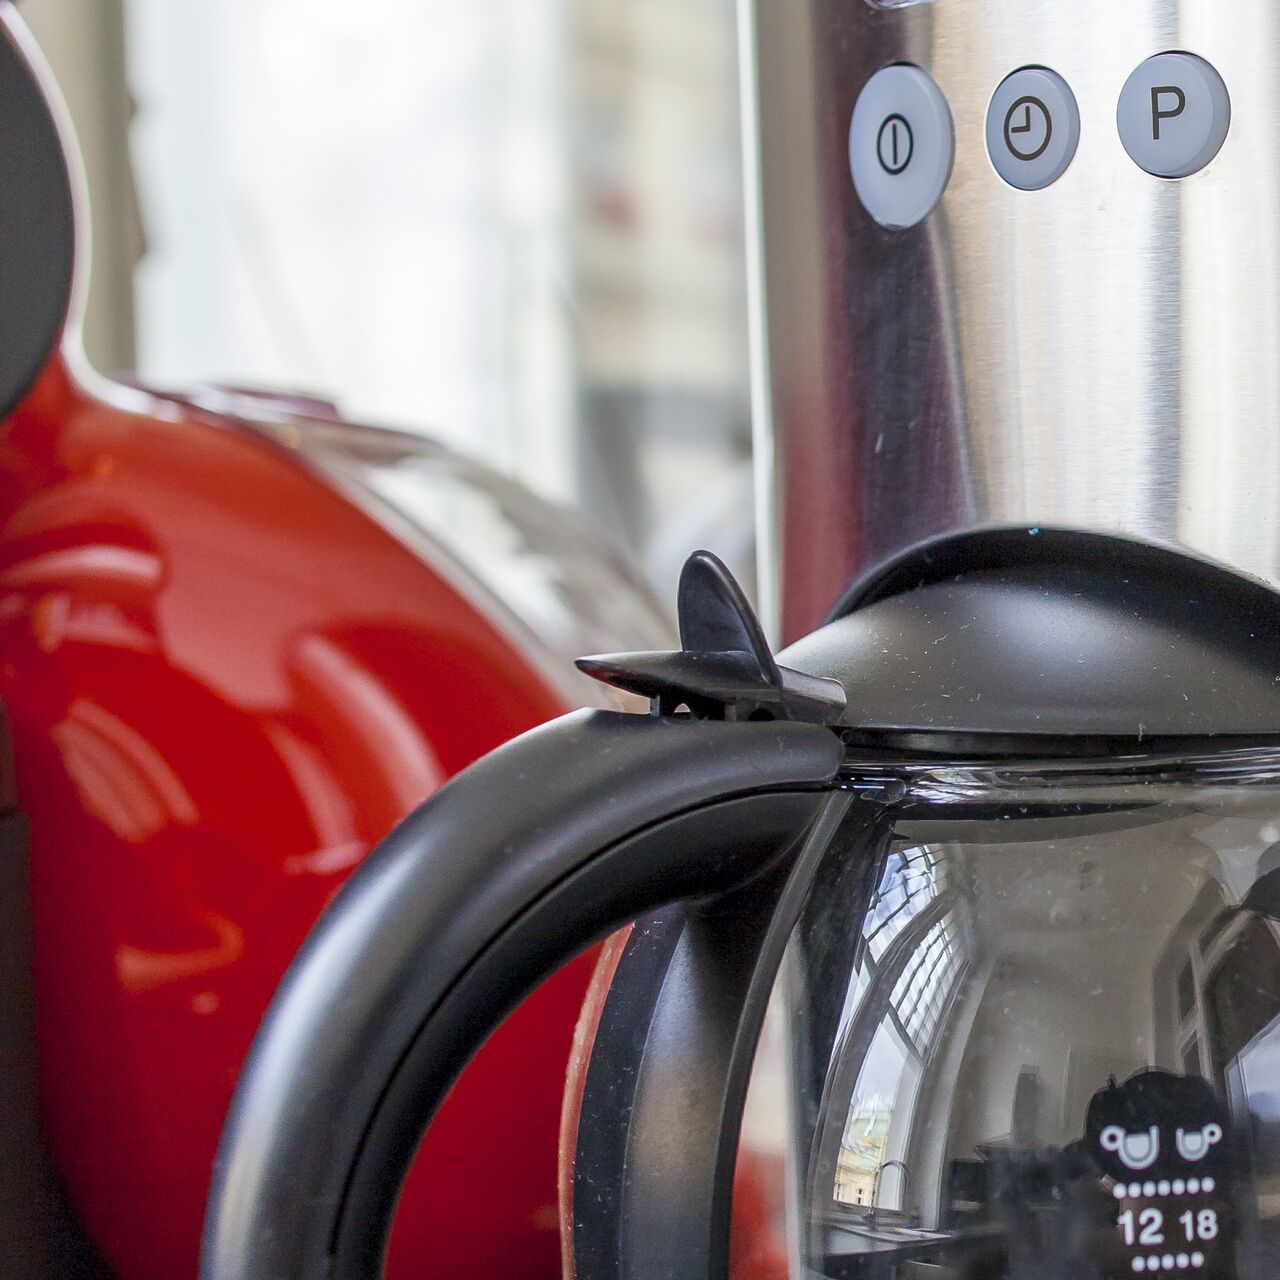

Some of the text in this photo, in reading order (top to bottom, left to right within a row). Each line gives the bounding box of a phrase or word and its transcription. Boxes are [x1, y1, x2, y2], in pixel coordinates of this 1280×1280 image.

[1150, 85, 1186, 140] P
[1117, 1207, 1219, 1246] 12 18
